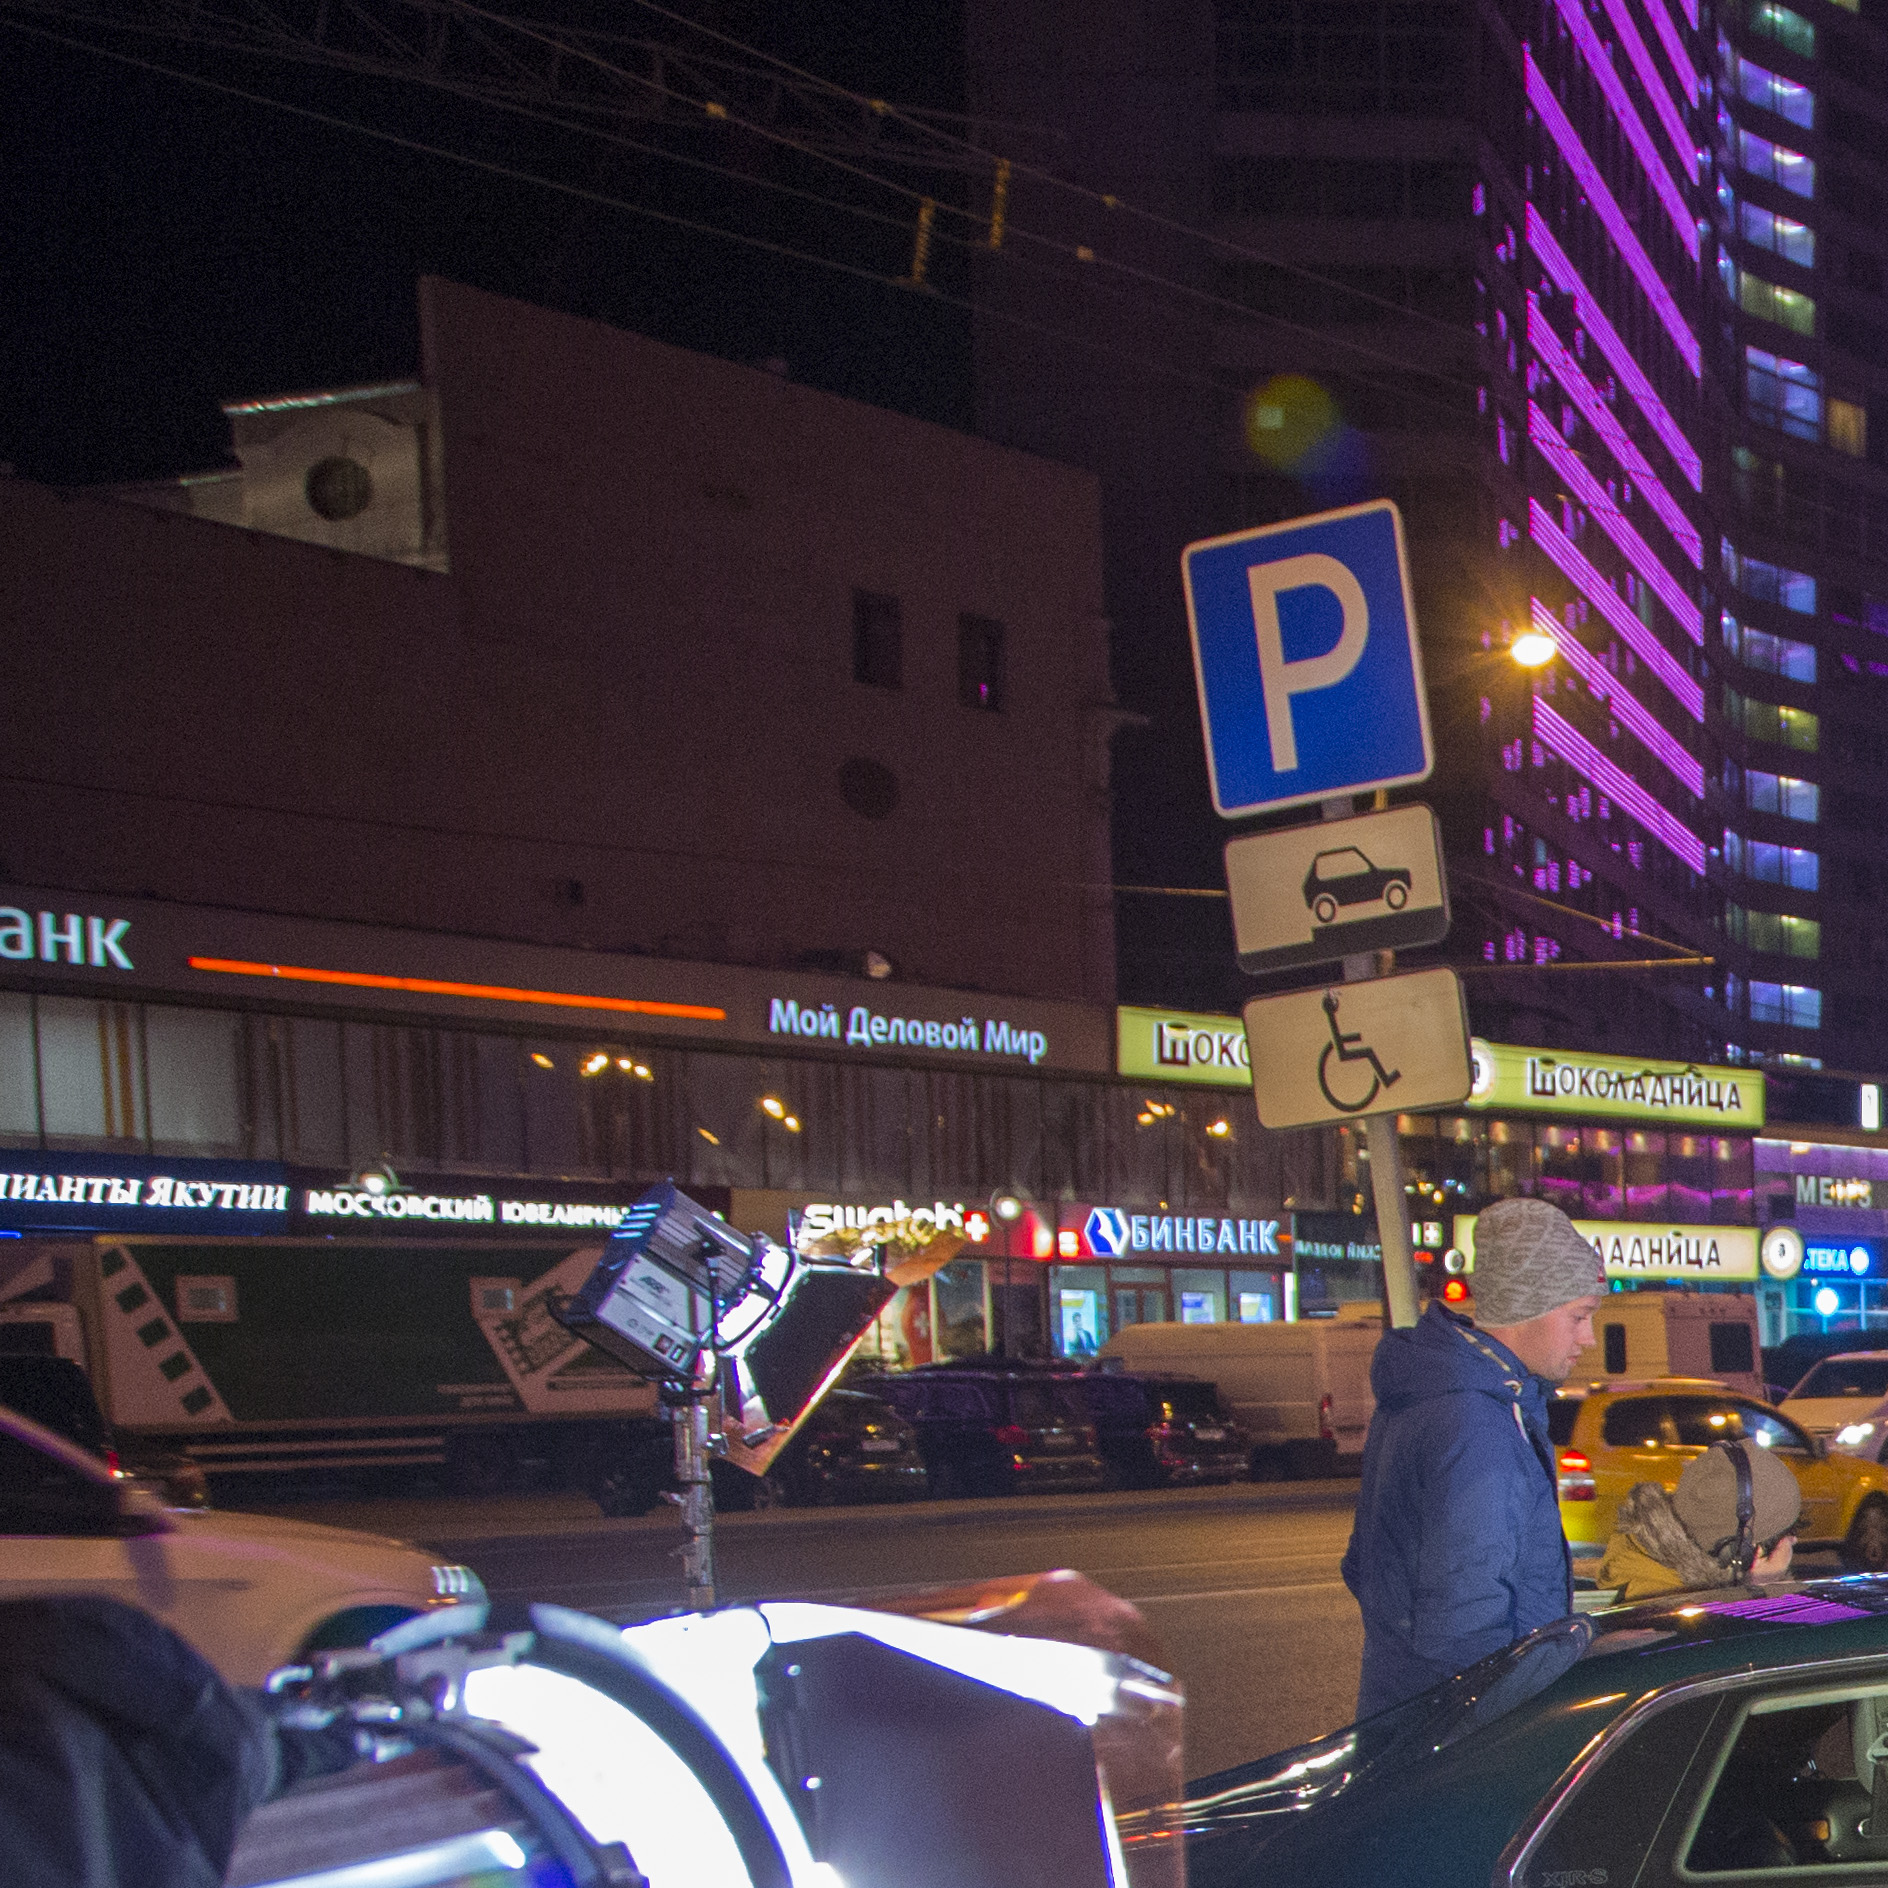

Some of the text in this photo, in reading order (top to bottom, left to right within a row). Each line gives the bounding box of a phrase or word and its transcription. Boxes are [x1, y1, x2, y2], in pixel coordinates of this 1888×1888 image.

[1247, 553, 1370, 773] P
[770, 998, 1047, 1065] Мой Деловой Мир
[146, 1176, 289, 1211] ЯКУТИИ
[1130, 1214, 1280, 1256] БИНБАНК
[1804, 1248, 1850, 1271] ТЕКА
